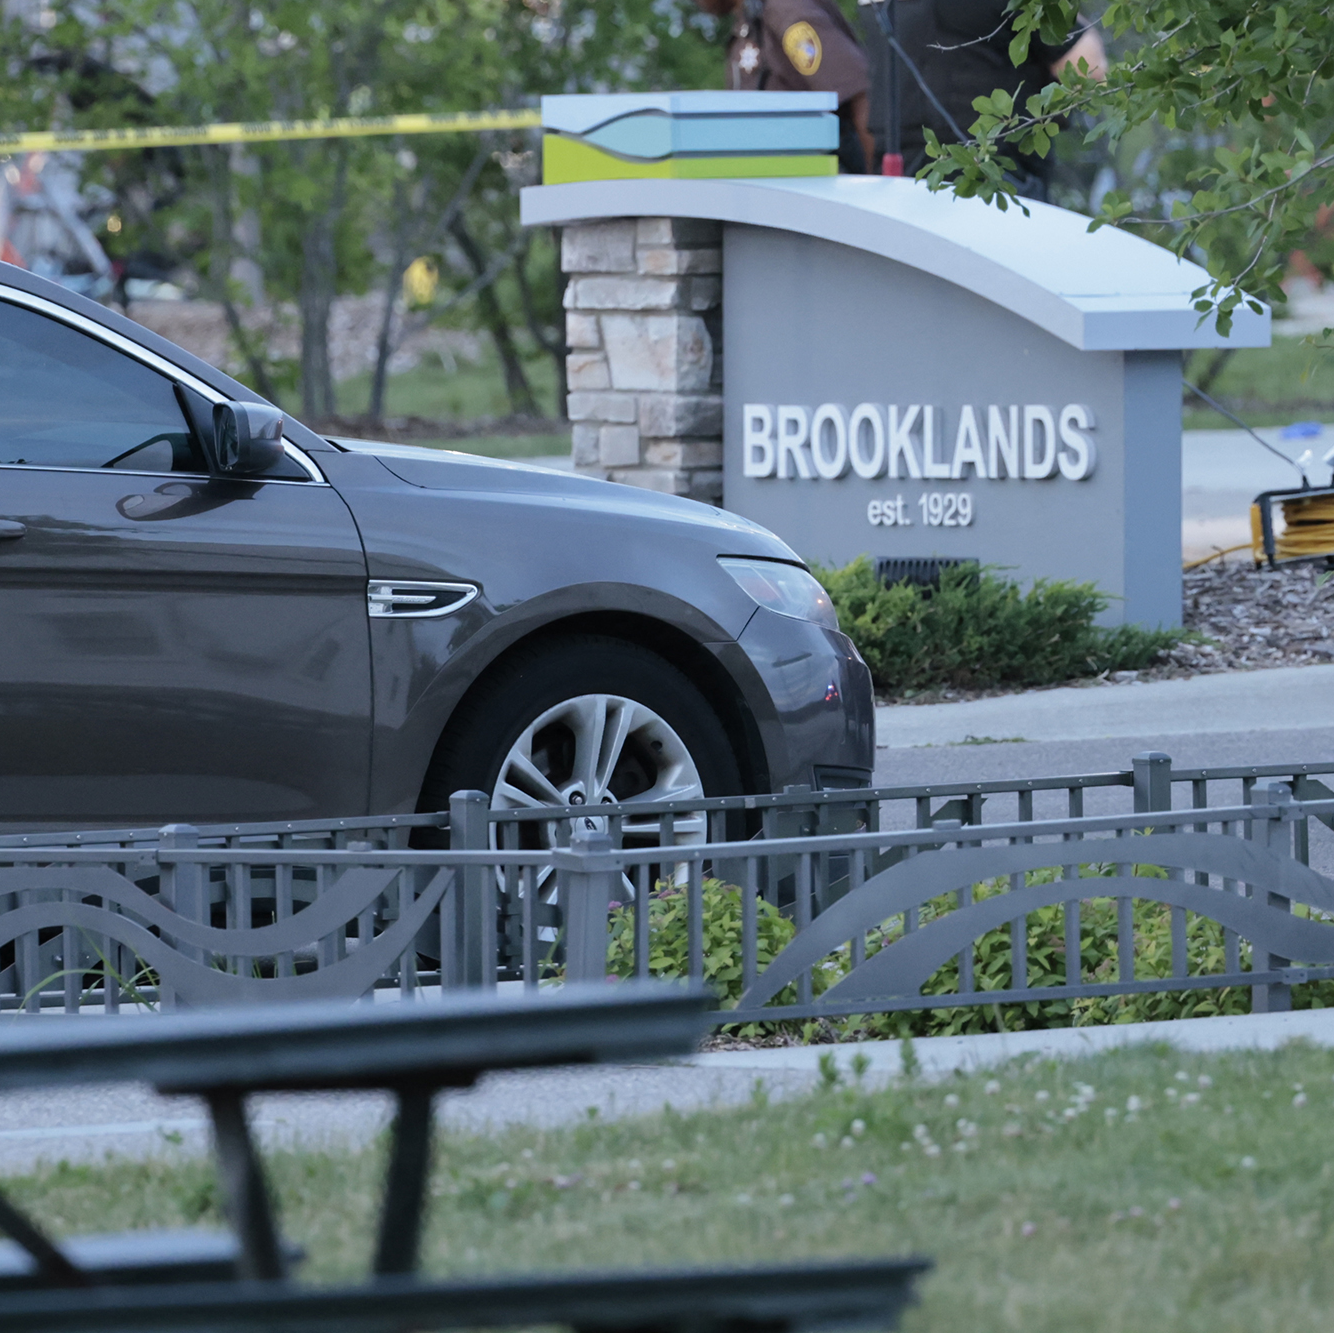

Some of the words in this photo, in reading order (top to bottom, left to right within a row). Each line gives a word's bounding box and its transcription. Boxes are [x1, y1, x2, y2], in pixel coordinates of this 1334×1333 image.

[742, 402, 1095, 481] BROOKLANDS
[867, 493, 911, 527] est.
[918, 492, 973, 527] 1929
